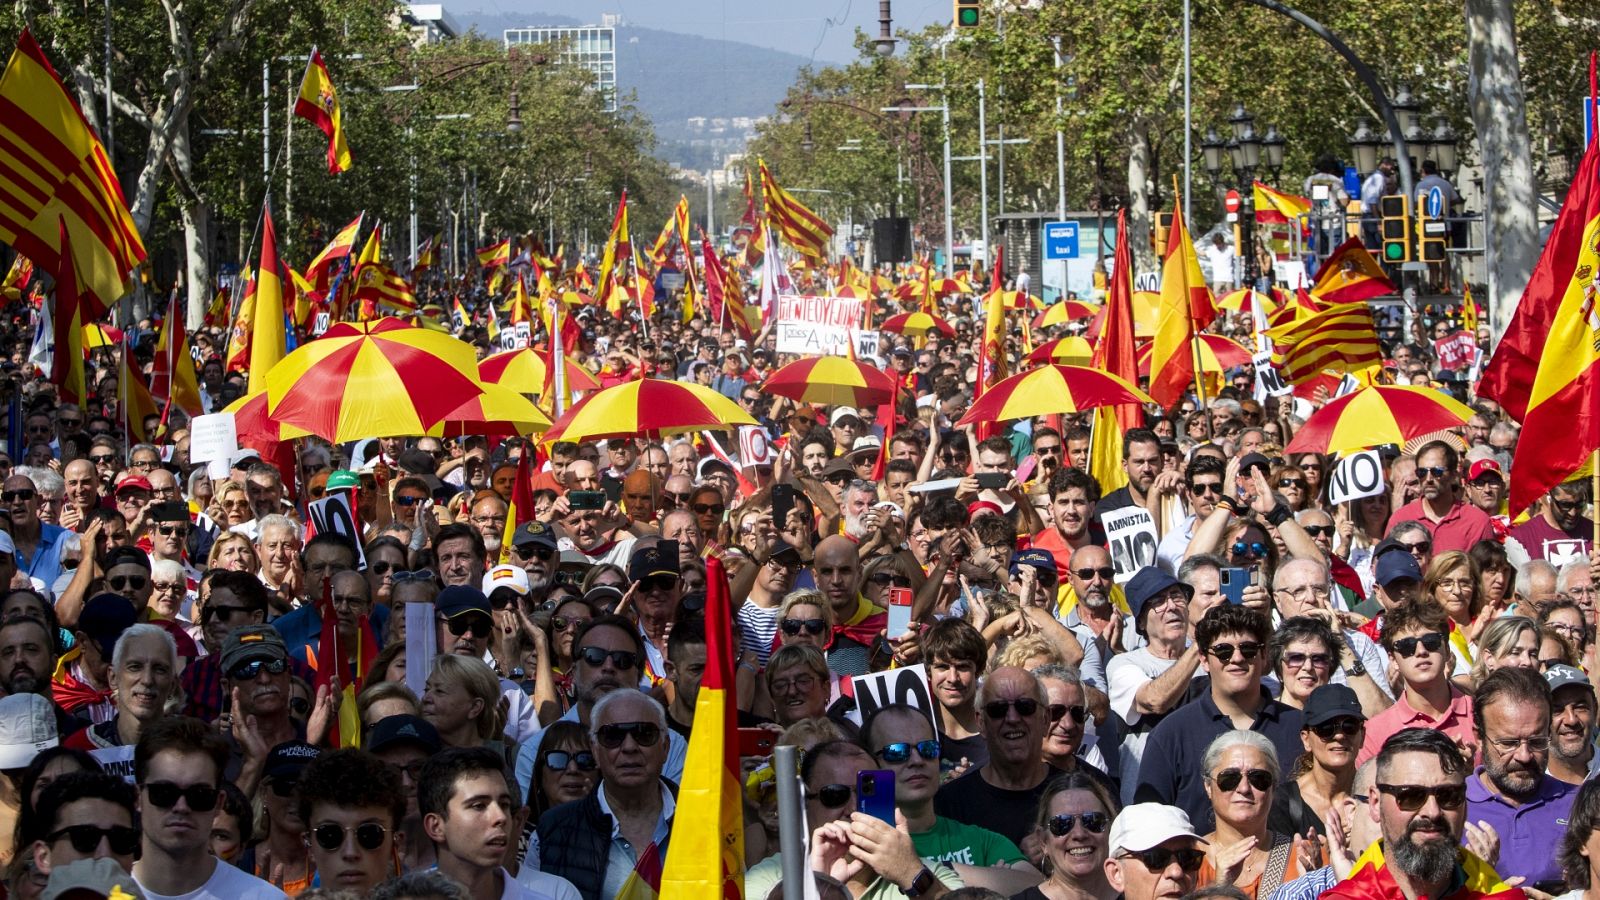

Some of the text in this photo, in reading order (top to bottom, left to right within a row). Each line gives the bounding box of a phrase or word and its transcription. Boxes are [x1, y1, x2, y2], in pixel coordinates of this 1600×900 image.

[1056, 246, 1070, 254] taxi
[502, 337, 515, 351] NO
[860, 341, 877, 355] NO
[741, 429, 768, 464] NO
[1331, 453, 1379, 500] NO
[1112, 531, 1157, 575] NO
[1546, 666, 1574, 681] NY
